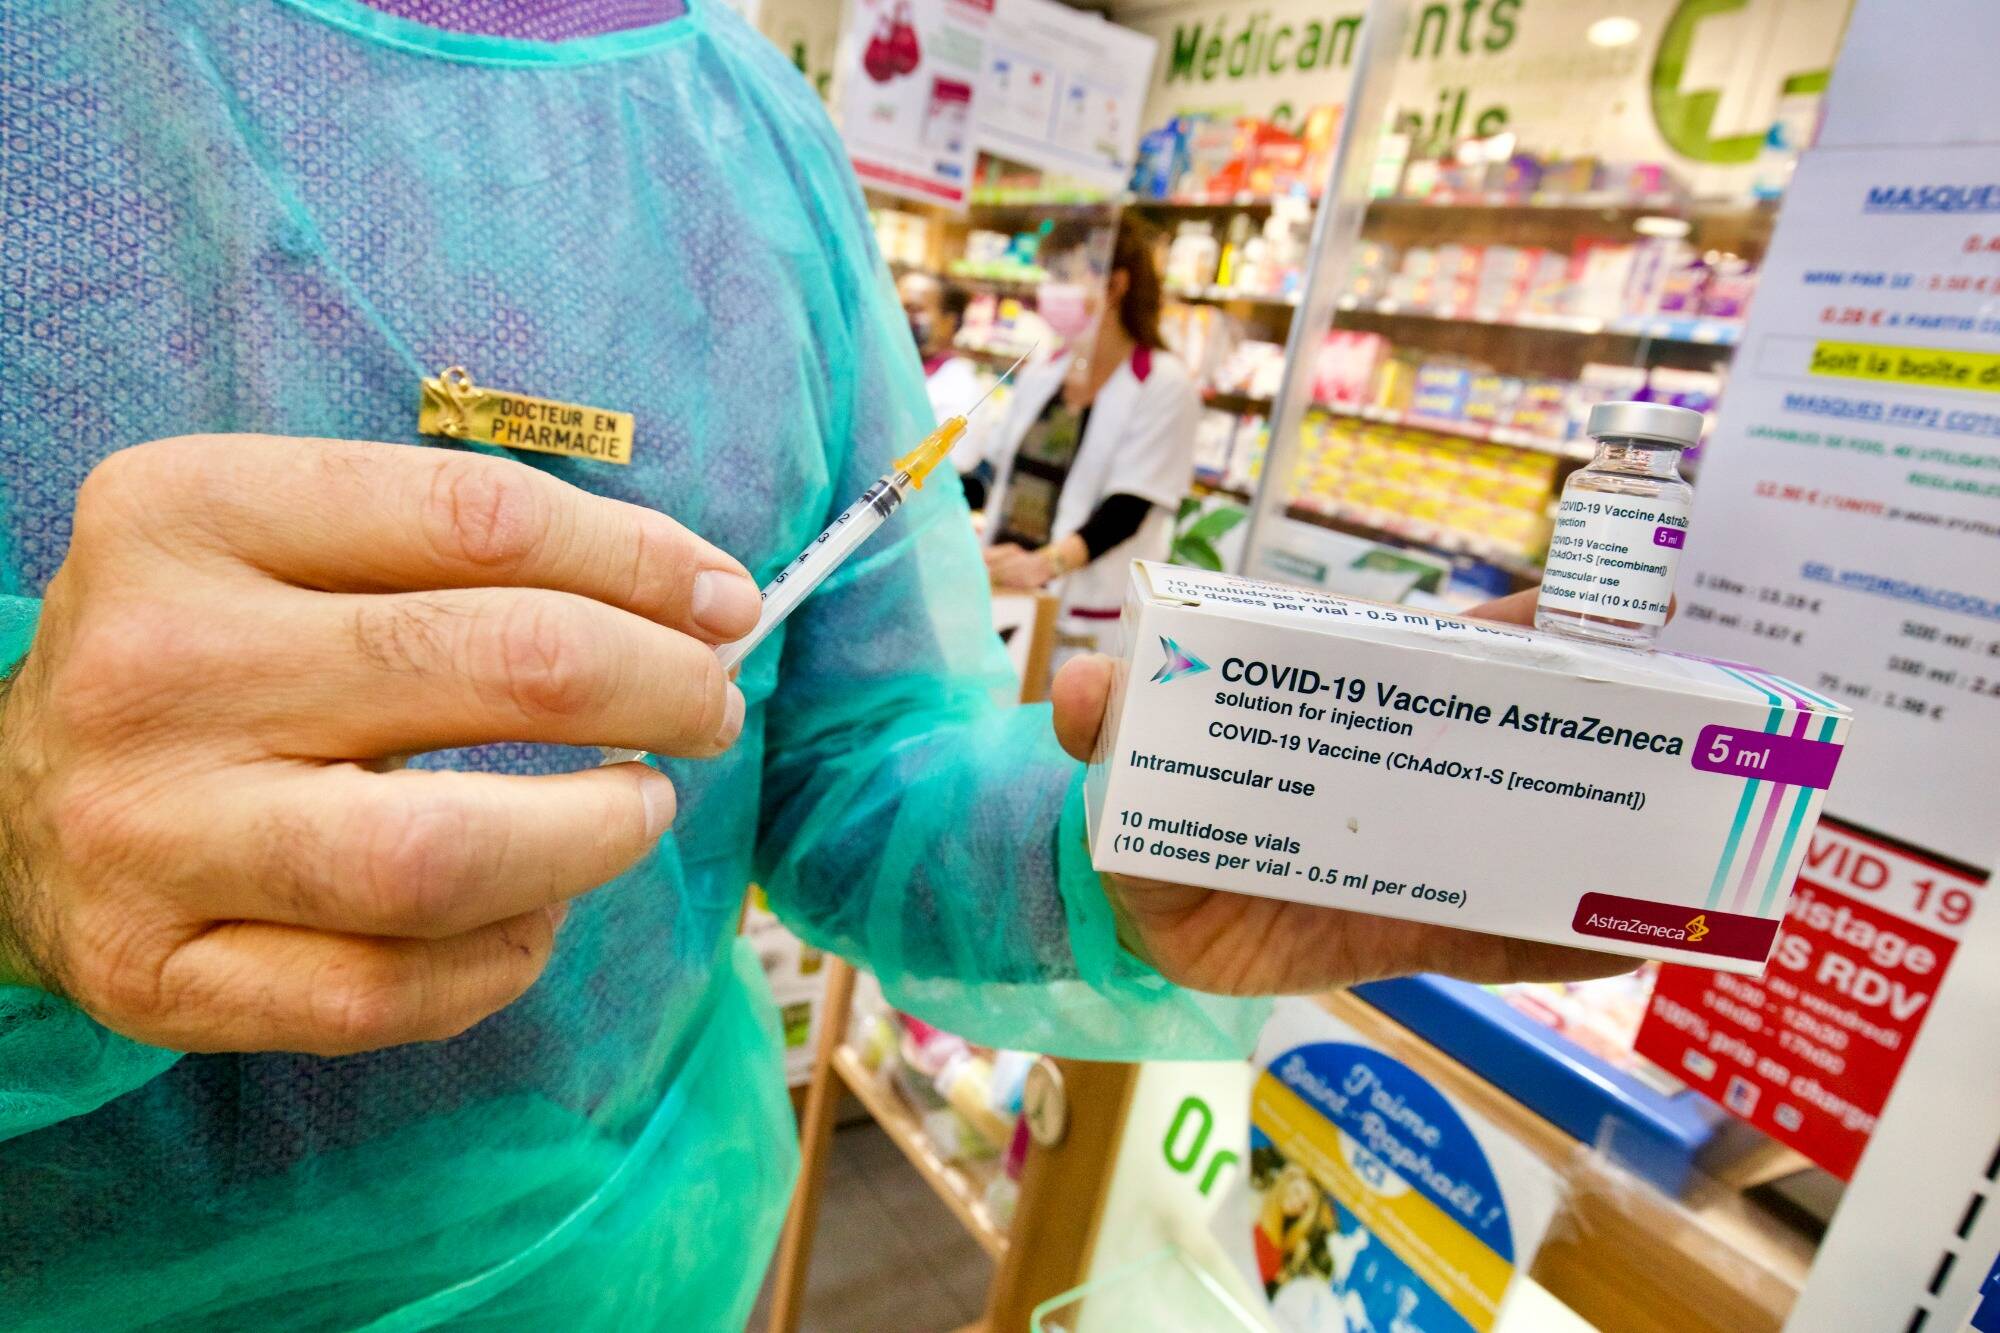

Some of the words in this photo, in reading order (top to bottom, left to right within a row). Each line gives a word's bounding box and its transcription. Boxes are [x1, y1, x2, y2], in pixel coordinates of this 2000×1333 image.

[501, 399, 583, 427] DOCTEUR
[594, 415, 616, 433] EN
[491, 418, 620, 459] PHARMACIE
[838, 513, 850, 524] 2
[1605, 504, 1655, 522] Vaccine
[818, 532, 830, 543] 3
[1587, 539, 1629, 554] Vaccine
[1659, 531, 1667, 543] 5
[1668, 536, 1678, 545] ml
[776, 572, 788, 583] 5
[1167, 579, 1189, 589] 10
[1193, 583, 1295, 601] multidose
[1301, 596, 1348, 607] vials
[1600, 576, 1620, 587] use
[1168, 586, 1199, 597] (10
[1203, 592, 1266, 607] doses
[1272, 601, 1305, 611] per
[1311, 606, 1348, 616] vial
[1367, 610, 1398, 622] 0.5
[1404, 615, 1428, 626] ml
[1579, 590, 1599, 602] vial
[1601, 594, 1620, 606] (10
[1623, 600, 1630, 608] x
[1632, 599, 1647, 610] 0.5
[1648, 601, 1659, 612] ml
[1215, 691, 1293, 716] solution
[1299, 703, 1327, 722] for
[1331, 707, 1414, 737] injection
[1222, 658, 1366, 703] COVID-19
[1376, 682, 1491, 724] Vaccine
[1499, 705, 1684, 756] AstraZeneca
[1208, 721, 1301, 751] COVID-19
[1307, 738, 1381, 765] Vaccine
[1387, 751, 1503, 786] (ChAdOx1-S
[1507, 771, 1647, 811] [recombinant])
[1708, 734, 1733, 763] 5
[1736, 749, 1770, 769] ml
[1130, 750, 1273, 790] Intramuscular
[1278, 778, 1315, 797] use
[1120, 811, 1142, 828] 10
[1148, 815, 1248, 845] multidose
[1254, 834, 1301, 855] vials
[1114, 834, 1144, 853] (10
[1150, 838, 1210, 864] doses
[1215, 852, 1250, 870] per
[1256, 856, 1290, 877] vial
[1308, 865, 1338, 885] 0.5
[1343, 872, 1367, 890] ml
[1372, 878, 1407, 896] per
[1411, 883, 1467, 909] dose)
[1912, 879, 1974, 926] 19
[1586, 913, 1686, 941] AstraZeneca
[1789, 888, 1937, 976] istage
[1815, 951, 1928, 1021] RDV
